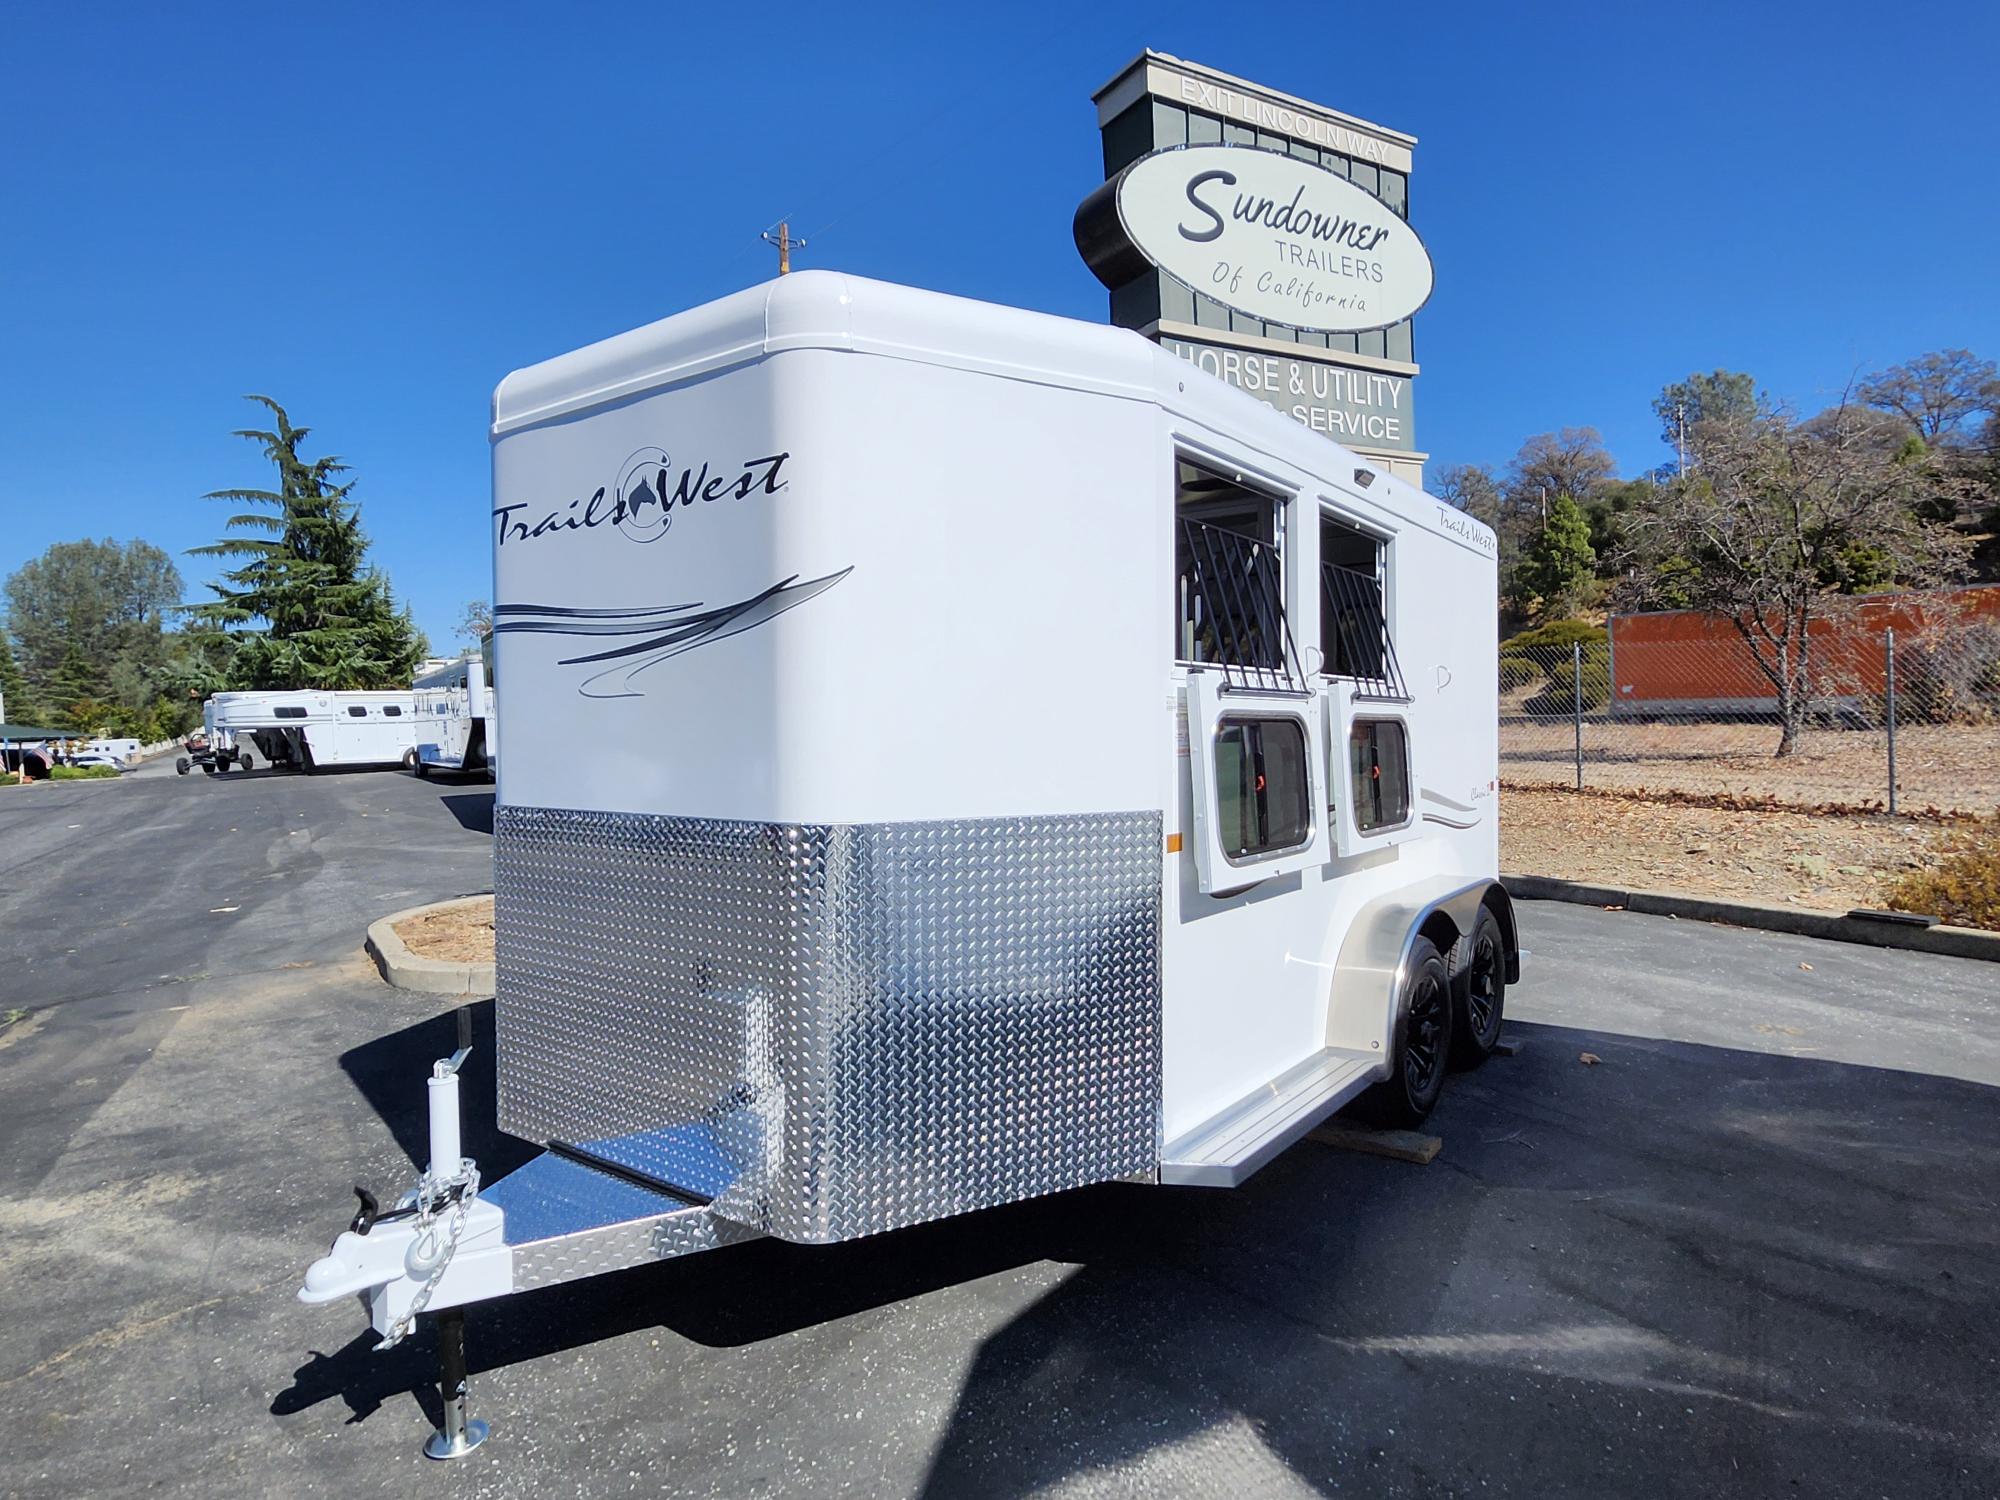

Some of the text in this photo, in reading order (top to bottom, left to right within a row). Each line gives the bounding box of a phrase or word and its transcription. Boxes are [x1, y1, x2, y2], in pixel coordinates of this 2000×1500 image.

[1180, 75, 1390, 163] EXIT LINCOLN WAY
[1177, 169, 1389, 251] Sundowner
[1212, 261, 1367, 312] Of California
[1274, 239, 1384, 284] TRAILERS
[1289, 362, 1306, 395] &
[1311, 365, 1402, 409] UTILITY
[1292, 404, 1400, 441] SERVICE
[492, 452, 790, 546] Trails West
